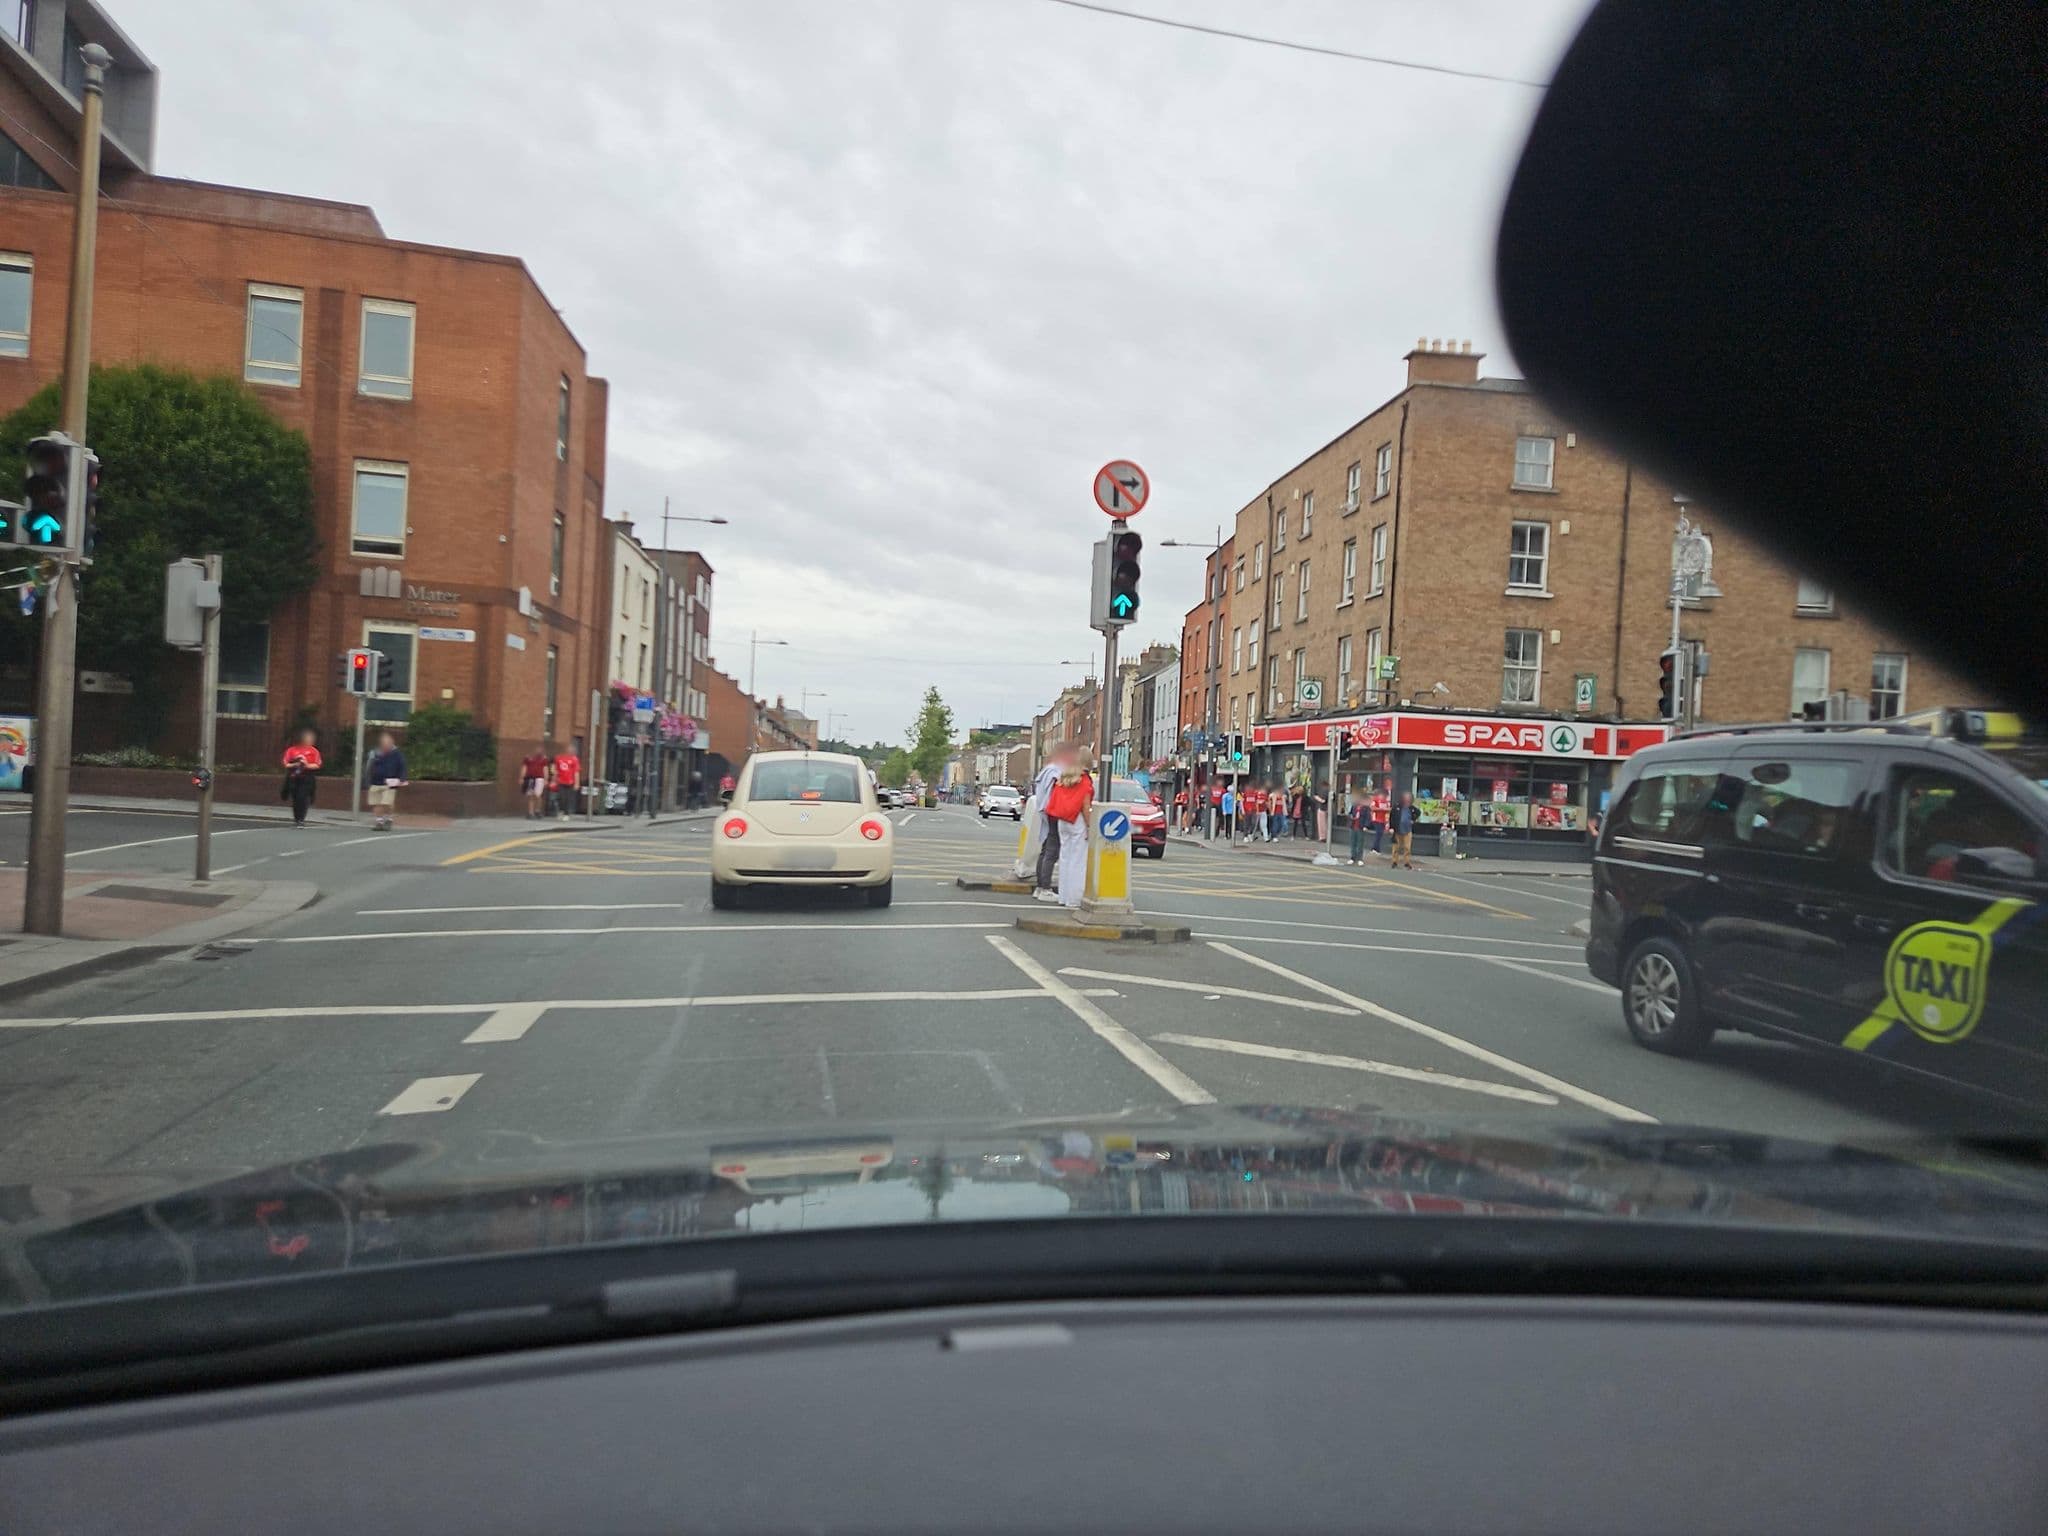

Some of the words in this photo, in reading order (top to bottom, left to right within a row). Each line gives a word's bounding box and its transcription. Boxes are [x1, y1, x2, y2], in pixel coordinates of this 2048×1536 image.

[407, 585, 460, 601] Mater
[1443, 724, 1544, 748] SPAR
[1900, 954, 1971, 1004] TAXI
